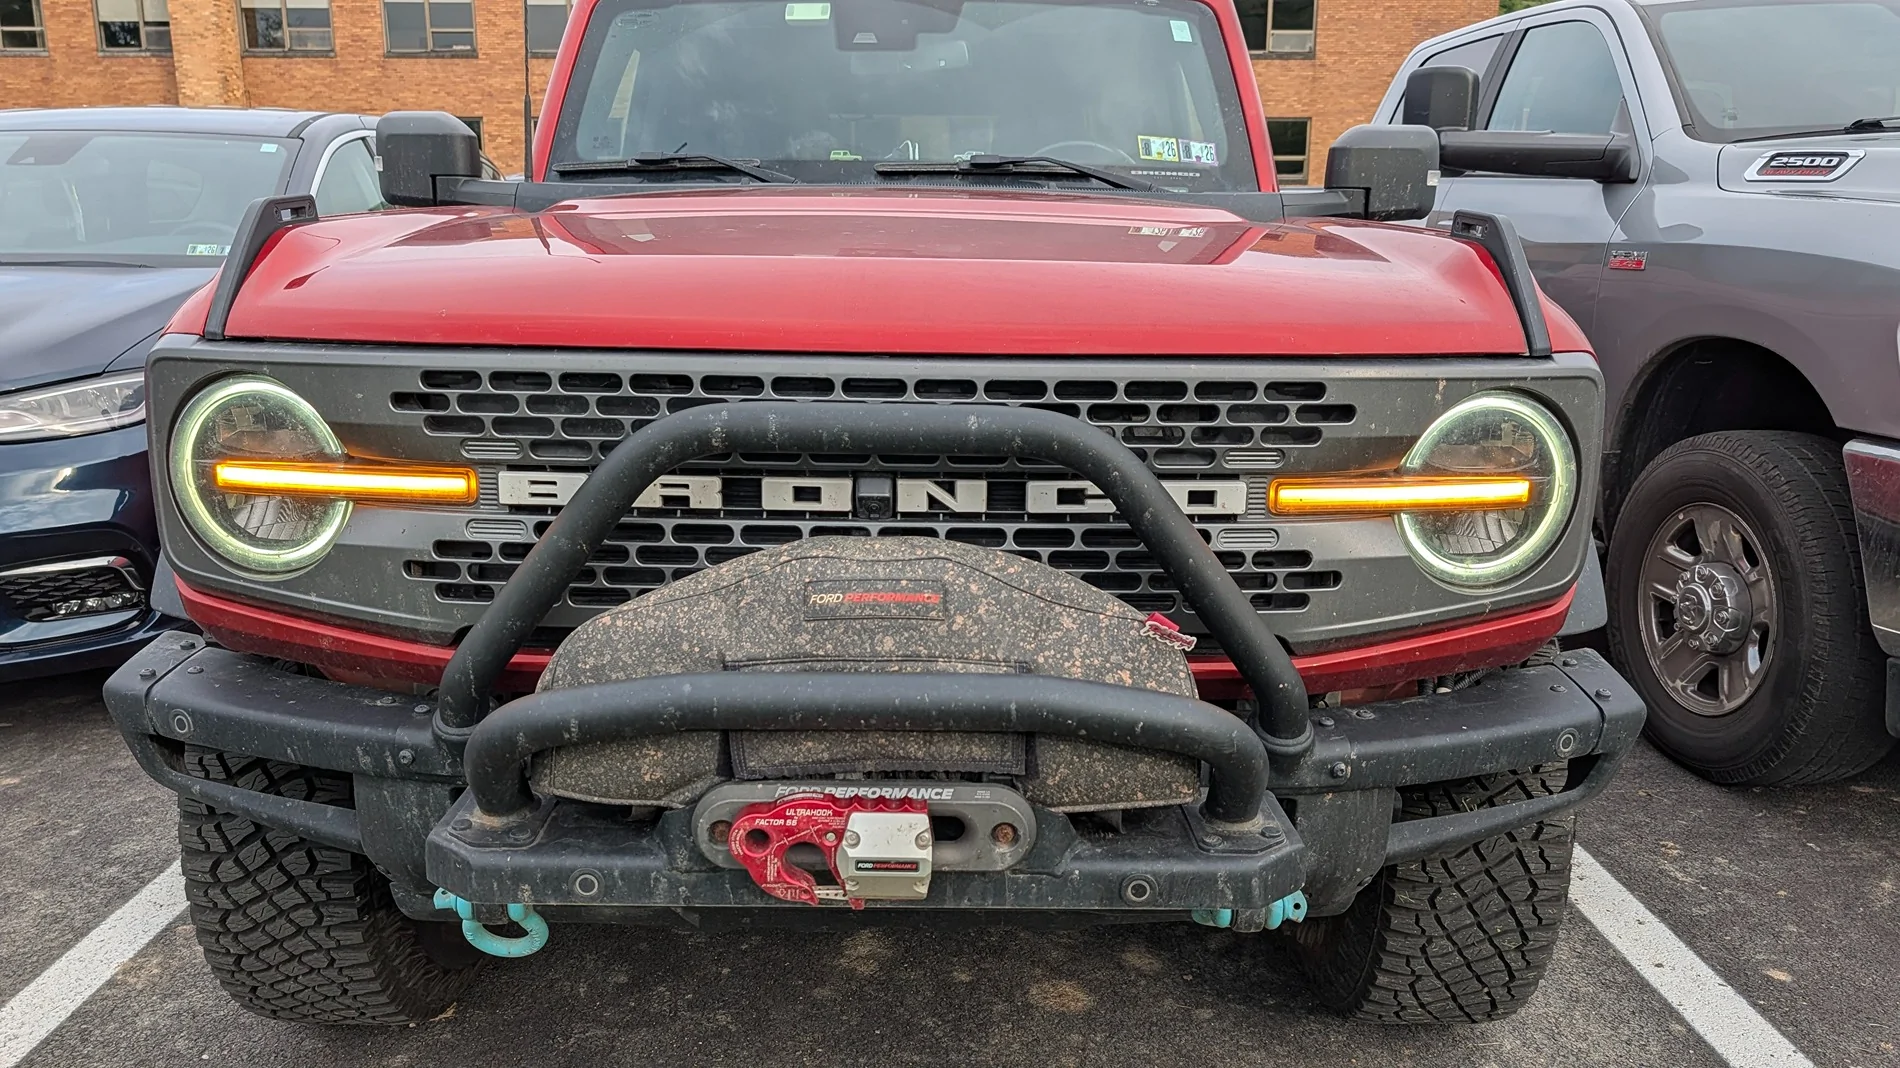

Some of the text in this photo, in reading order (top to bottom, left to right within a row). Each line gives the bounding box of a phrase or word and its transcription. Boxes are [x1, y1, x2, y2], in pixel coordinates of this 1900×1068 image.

[1770, 156, 1840, 168] 2500
[498, 471, 1247, 515] BRONCO
[809, 592, 940, 605] FORD PERFORMANCE
[824, 787, 954, 800] PERFORMANCE
[786, 808, 833, 817] ULTRAHOOK
